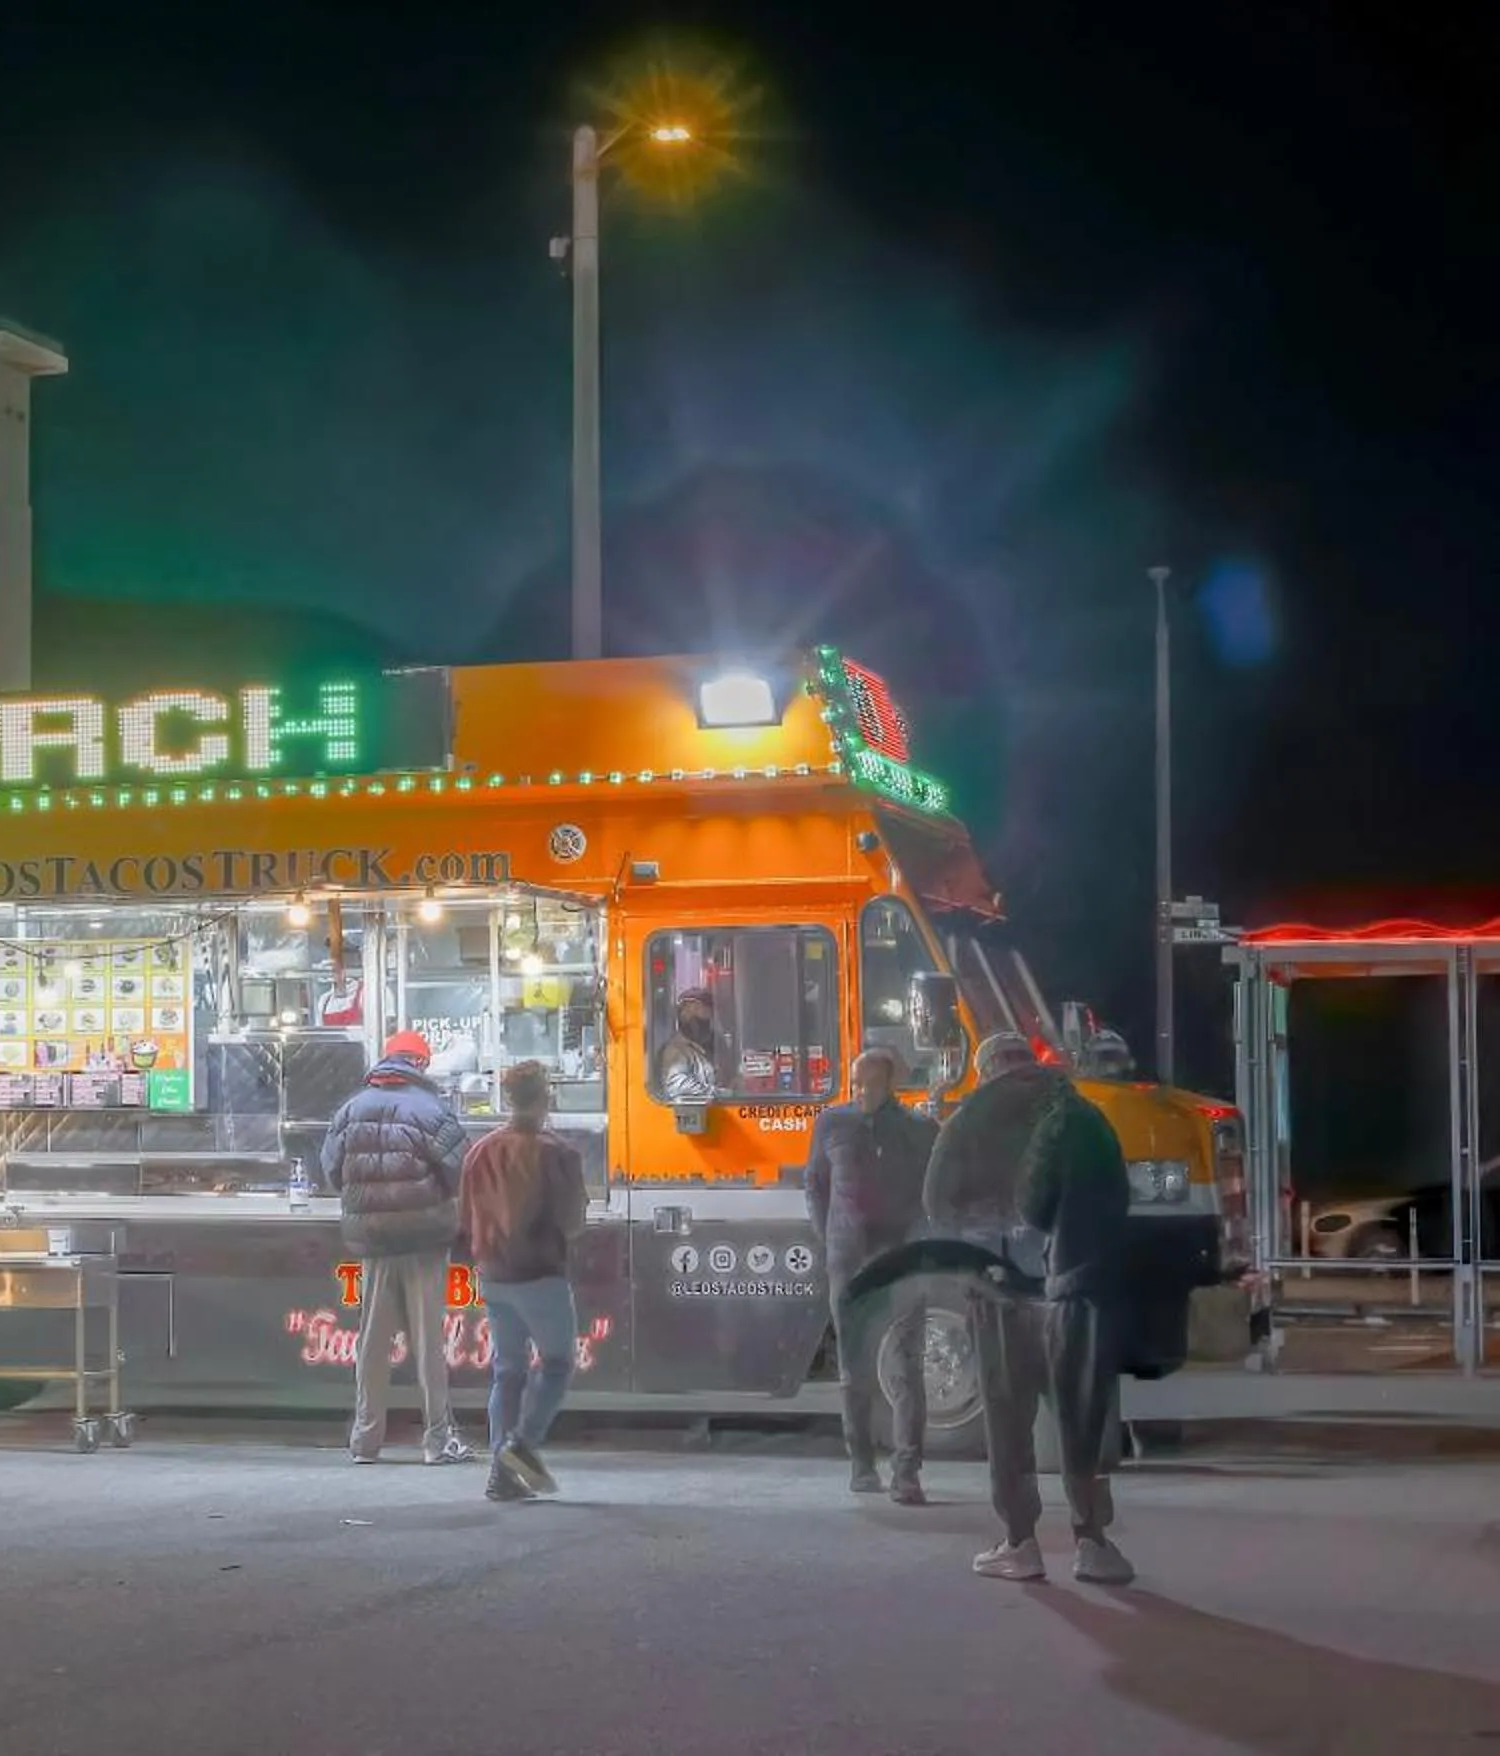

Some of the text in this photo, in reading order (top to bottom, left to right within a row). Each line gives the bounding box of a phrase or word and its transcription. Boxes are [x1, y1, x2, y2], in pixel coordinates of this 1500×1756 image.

[411, 1016, 481, 1031] PICK-UP
[739, 1104, 791, 1119] CREDIT
[759, 1118, 807, 1132] CASH
[671, 1280, 814, 1297] @LEOSTACOSTRUCK
